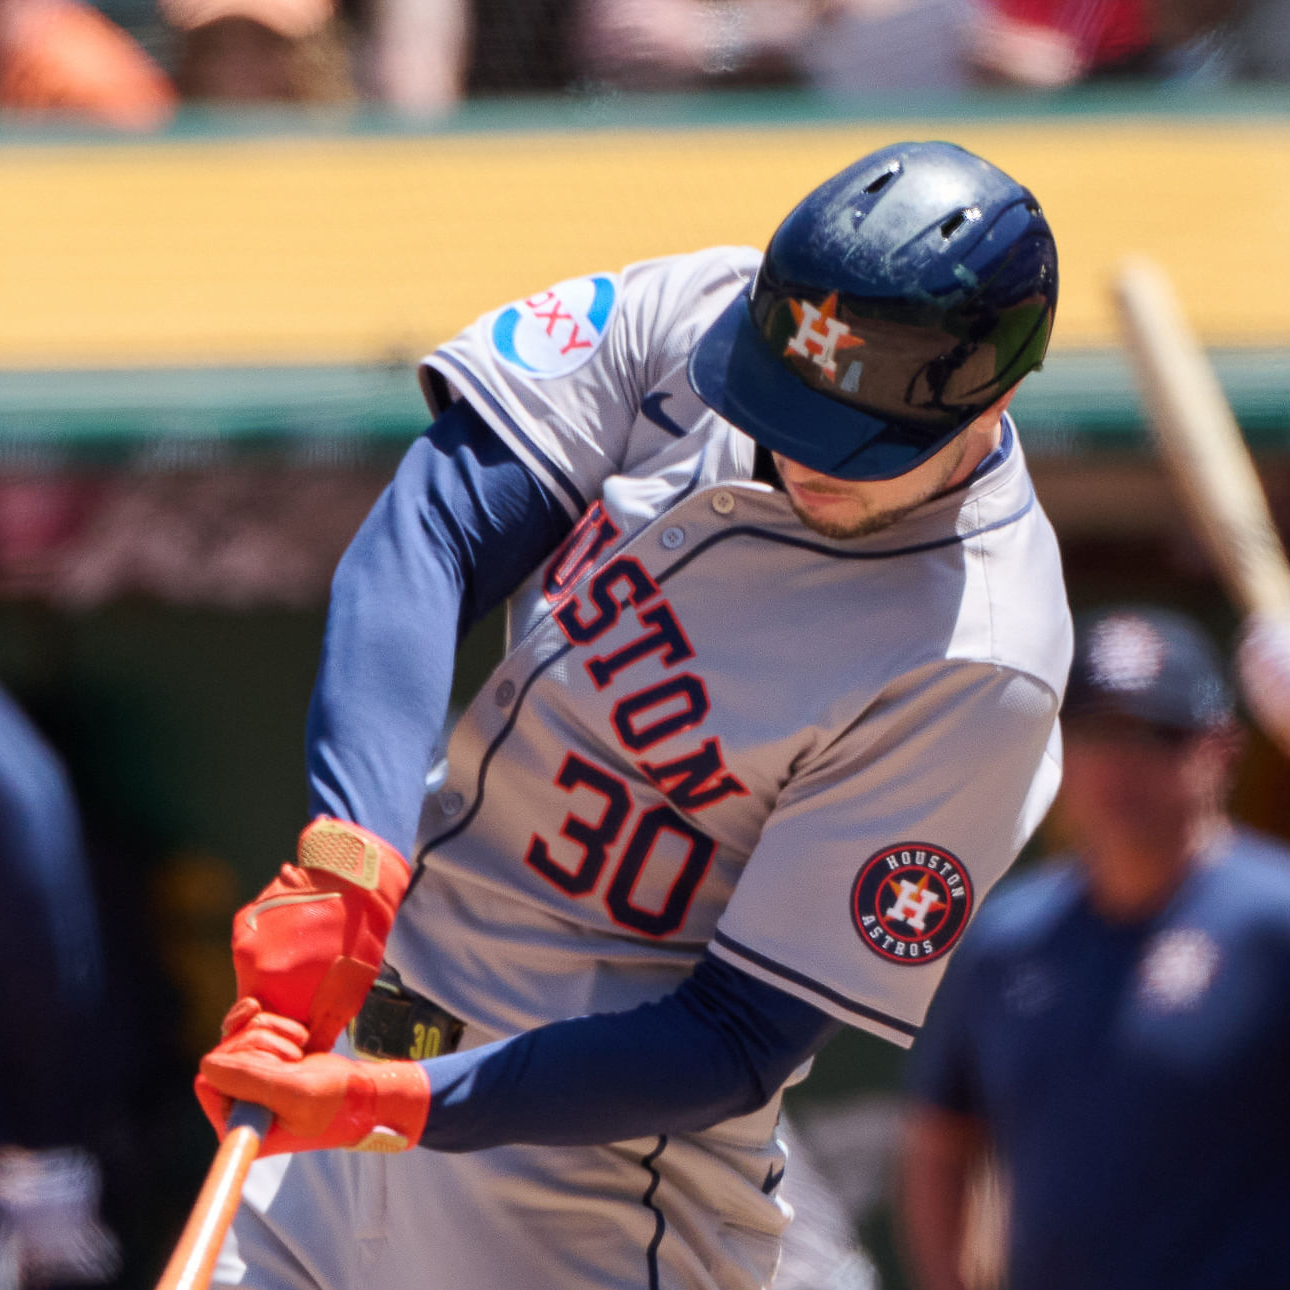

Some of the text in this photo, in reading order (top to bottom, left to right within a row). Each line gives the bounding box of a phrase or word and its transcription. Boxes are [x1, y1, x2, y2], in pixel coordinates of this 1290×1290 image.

[789, 300, 850, 372] H
[523, 750, 719, 941] 30
[886, 851, 965, 898] HOUSTON
[886, 880, 940, 931] H
[861, 915, 934, 957] ASTROS
[410, 1022, 440, 1060] 30
